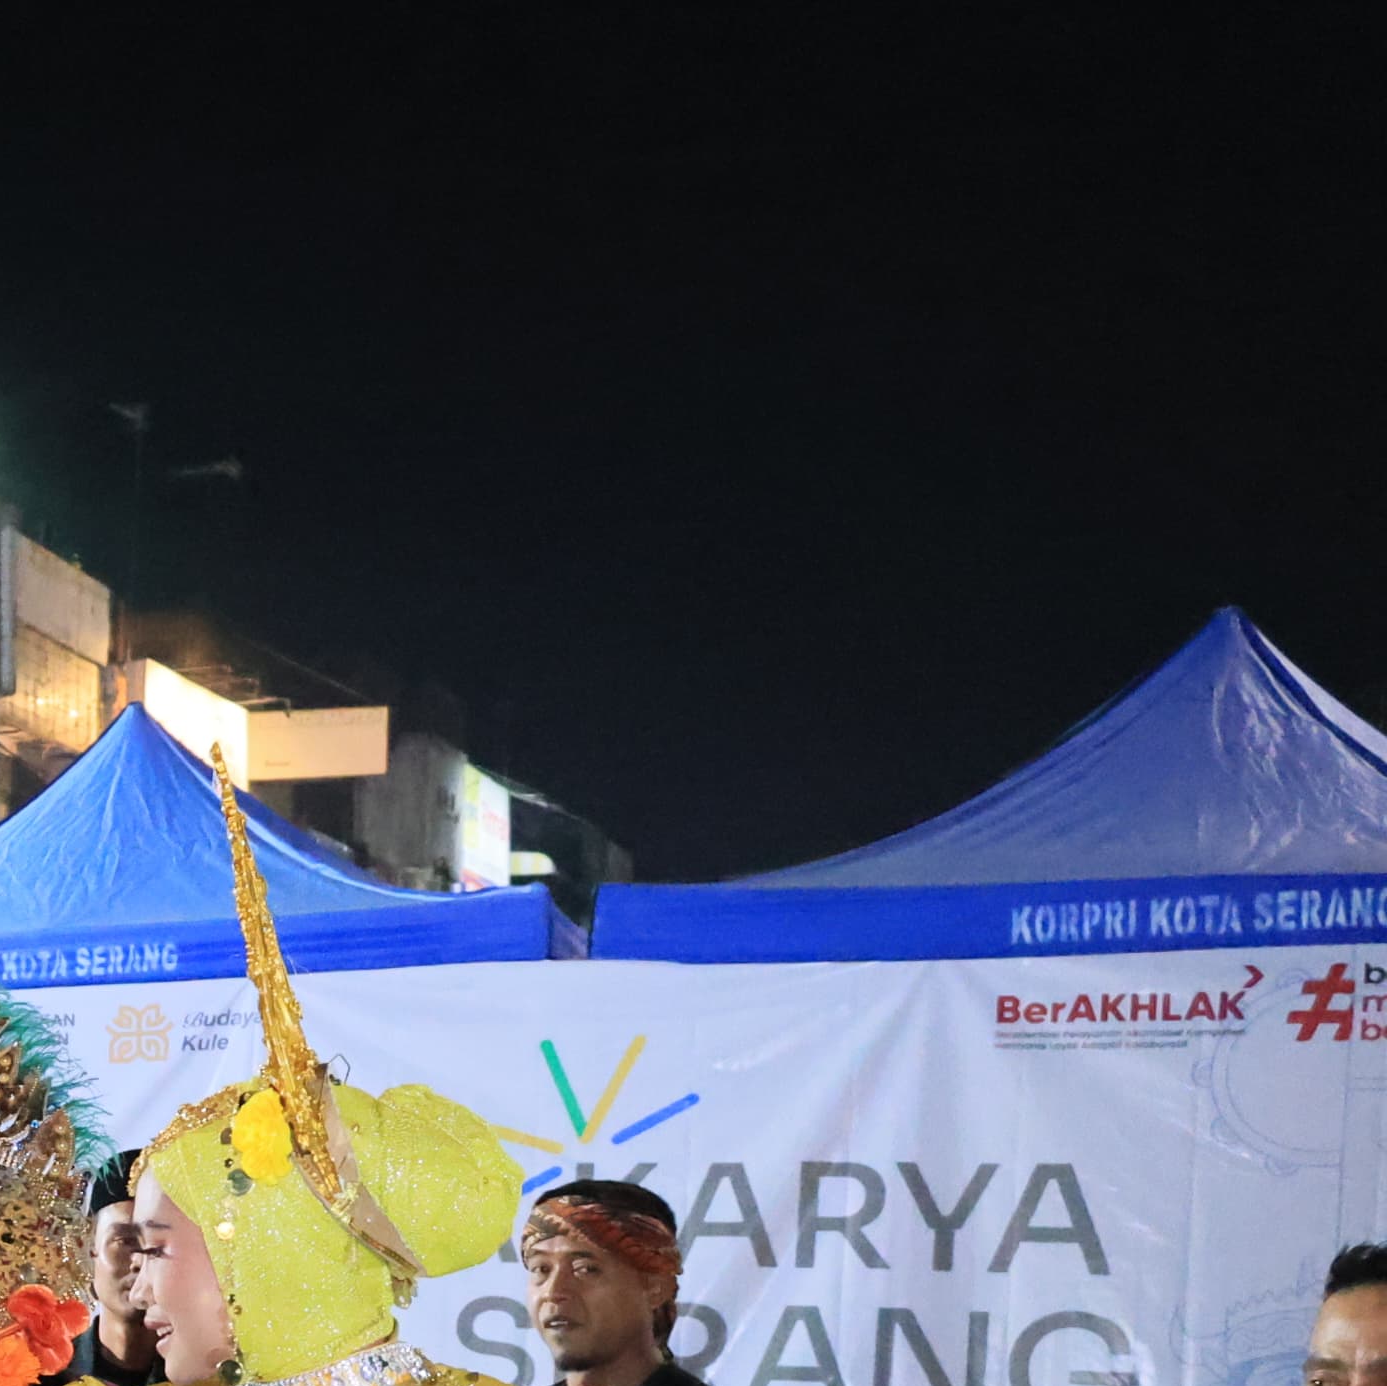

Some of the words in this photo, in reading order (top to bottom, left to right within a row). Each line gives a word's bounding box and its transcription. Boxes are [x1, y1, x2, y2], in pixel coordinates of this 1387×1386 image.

[1011, 899, 1137, 945] KORPRI
[1150, 894, 1243, 938] KOTA
[1, 949, 68, 981] KOTA
[74, 942, 178, 978] SERANG
[995, 990, 1247, 1025] BerAKHLAK
[182, 1034, 229, 1052] Kule
[571, 1161, 1112, 1277] ARYA
